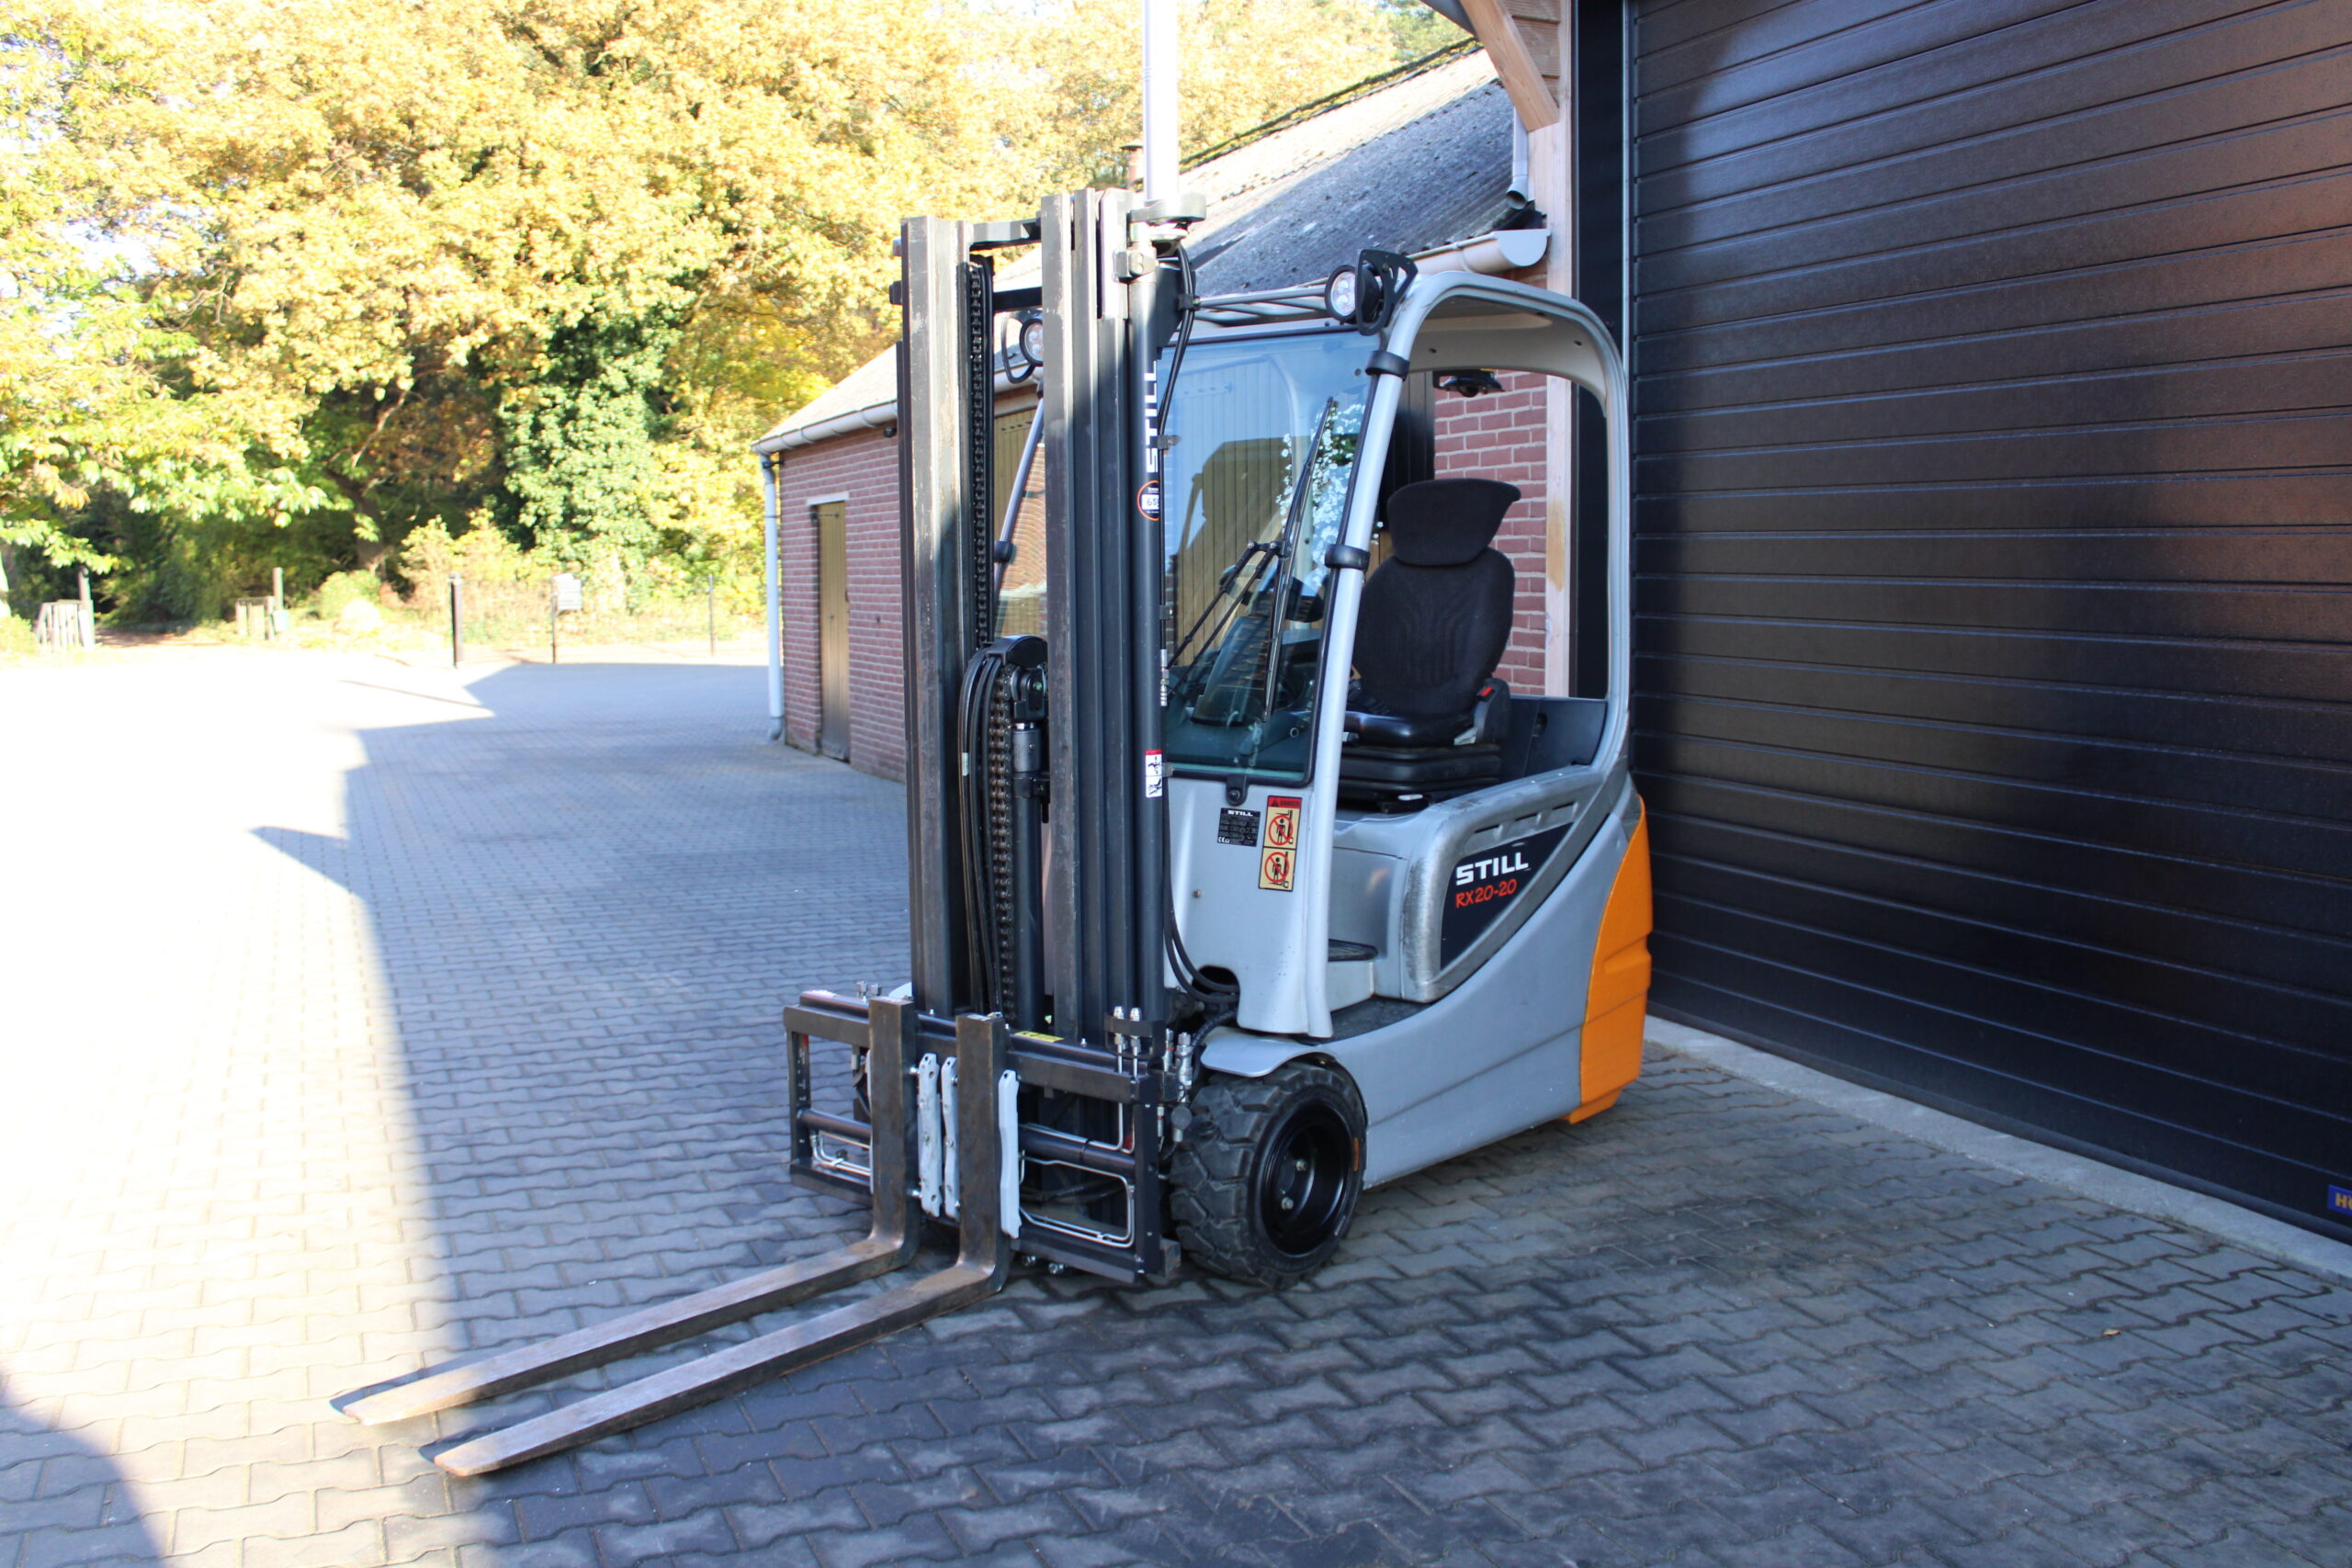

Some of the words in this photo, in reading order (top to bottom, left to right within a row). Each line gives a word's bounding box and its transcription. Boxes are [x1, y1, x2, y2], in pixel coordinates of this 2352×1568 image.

[1144, 360, 1158, 473] STILL
[1456, 852, 1529, 886] STILL
[1455, 879, 1517, 908] RX20-20
